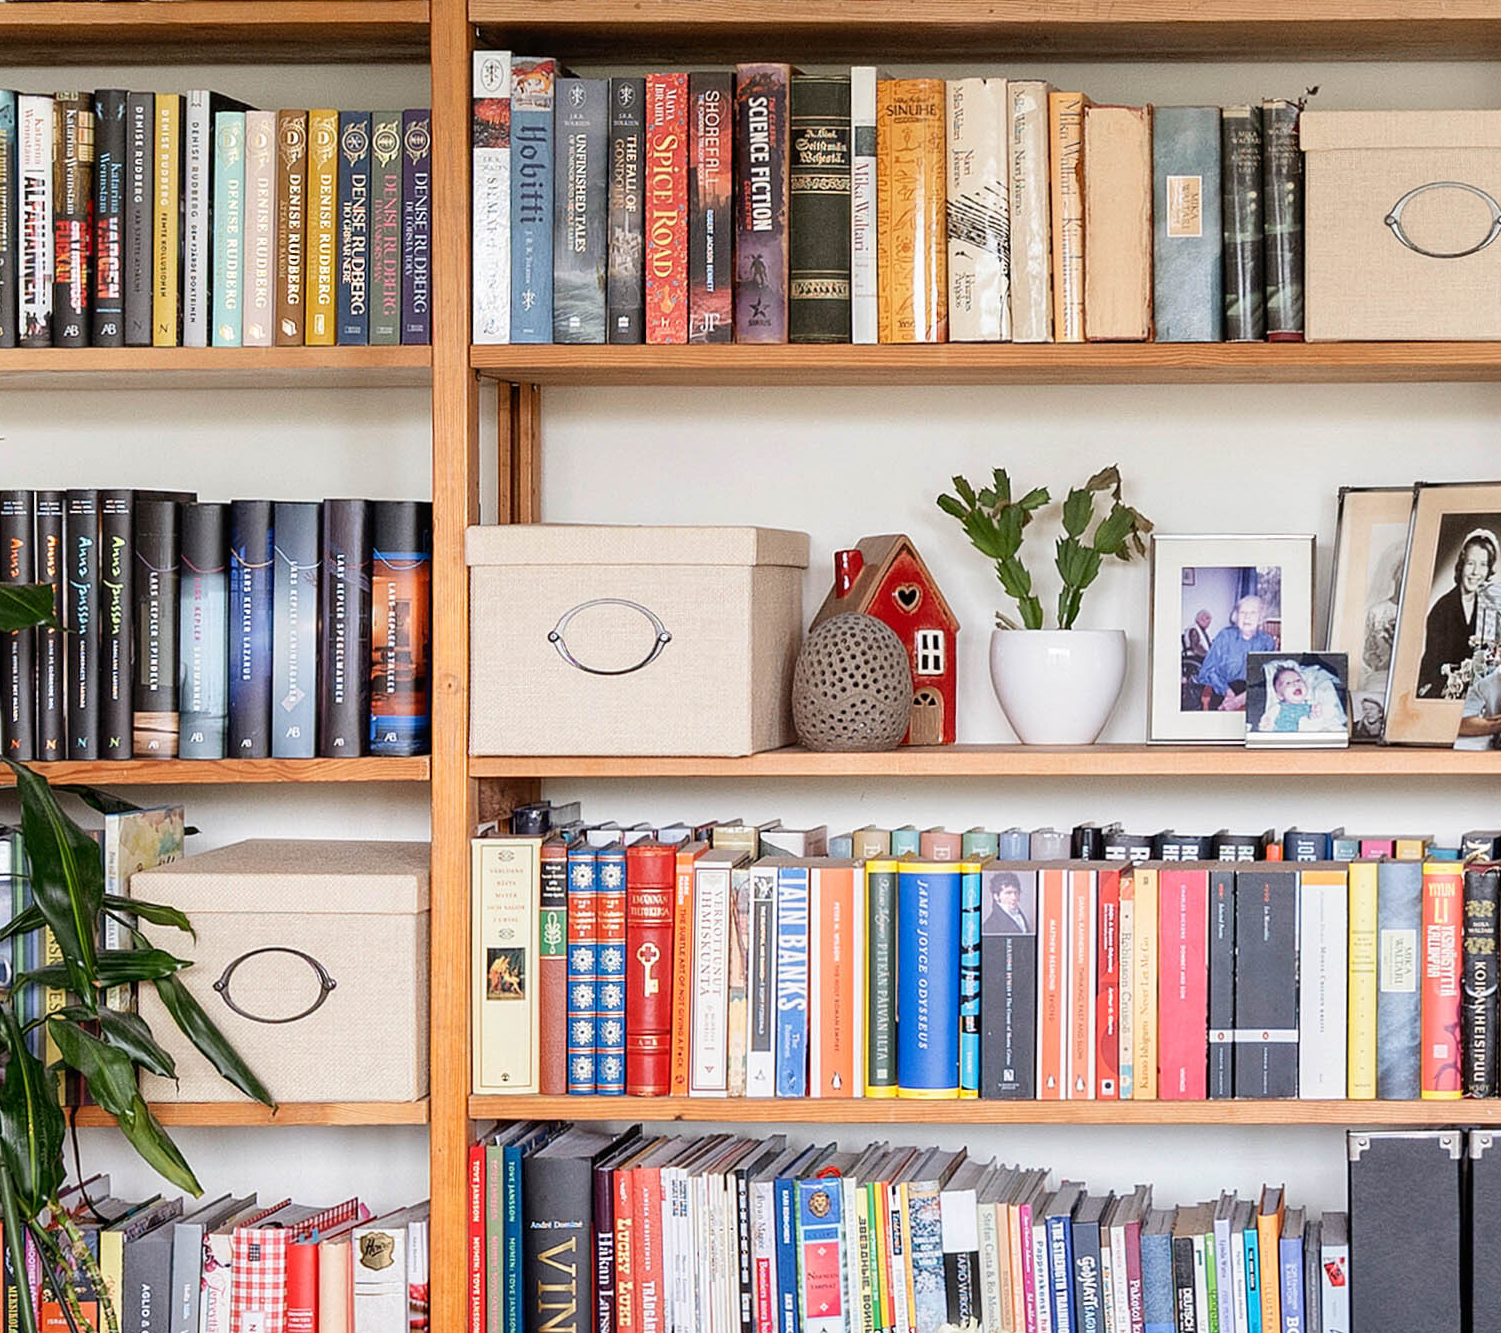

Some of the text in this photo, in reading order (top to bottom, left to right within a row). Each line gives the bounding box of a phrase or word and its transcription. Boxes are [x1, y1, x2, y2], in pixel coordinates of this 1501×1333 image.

[705, 90, 719, 188] SHOREFALL
[748, 97, 773, 231] SCIENCE FICTION
[886, 105, 936, 116] SINUHE
[626, 135, 637, 212] THE FALL OF
[286, 175, 301, 306] DENISE RUDBERG
[351, 176, 367, 315] DENISE RUDBERG
[652, 208, 678, 277] ROAD
[778, 876, 806, 1011] IAIN BANKS
[917, 880, 929, 1049] JAMES JOYCE ODYSSEUS
[597, 1233, 612, 1284] Håkan
